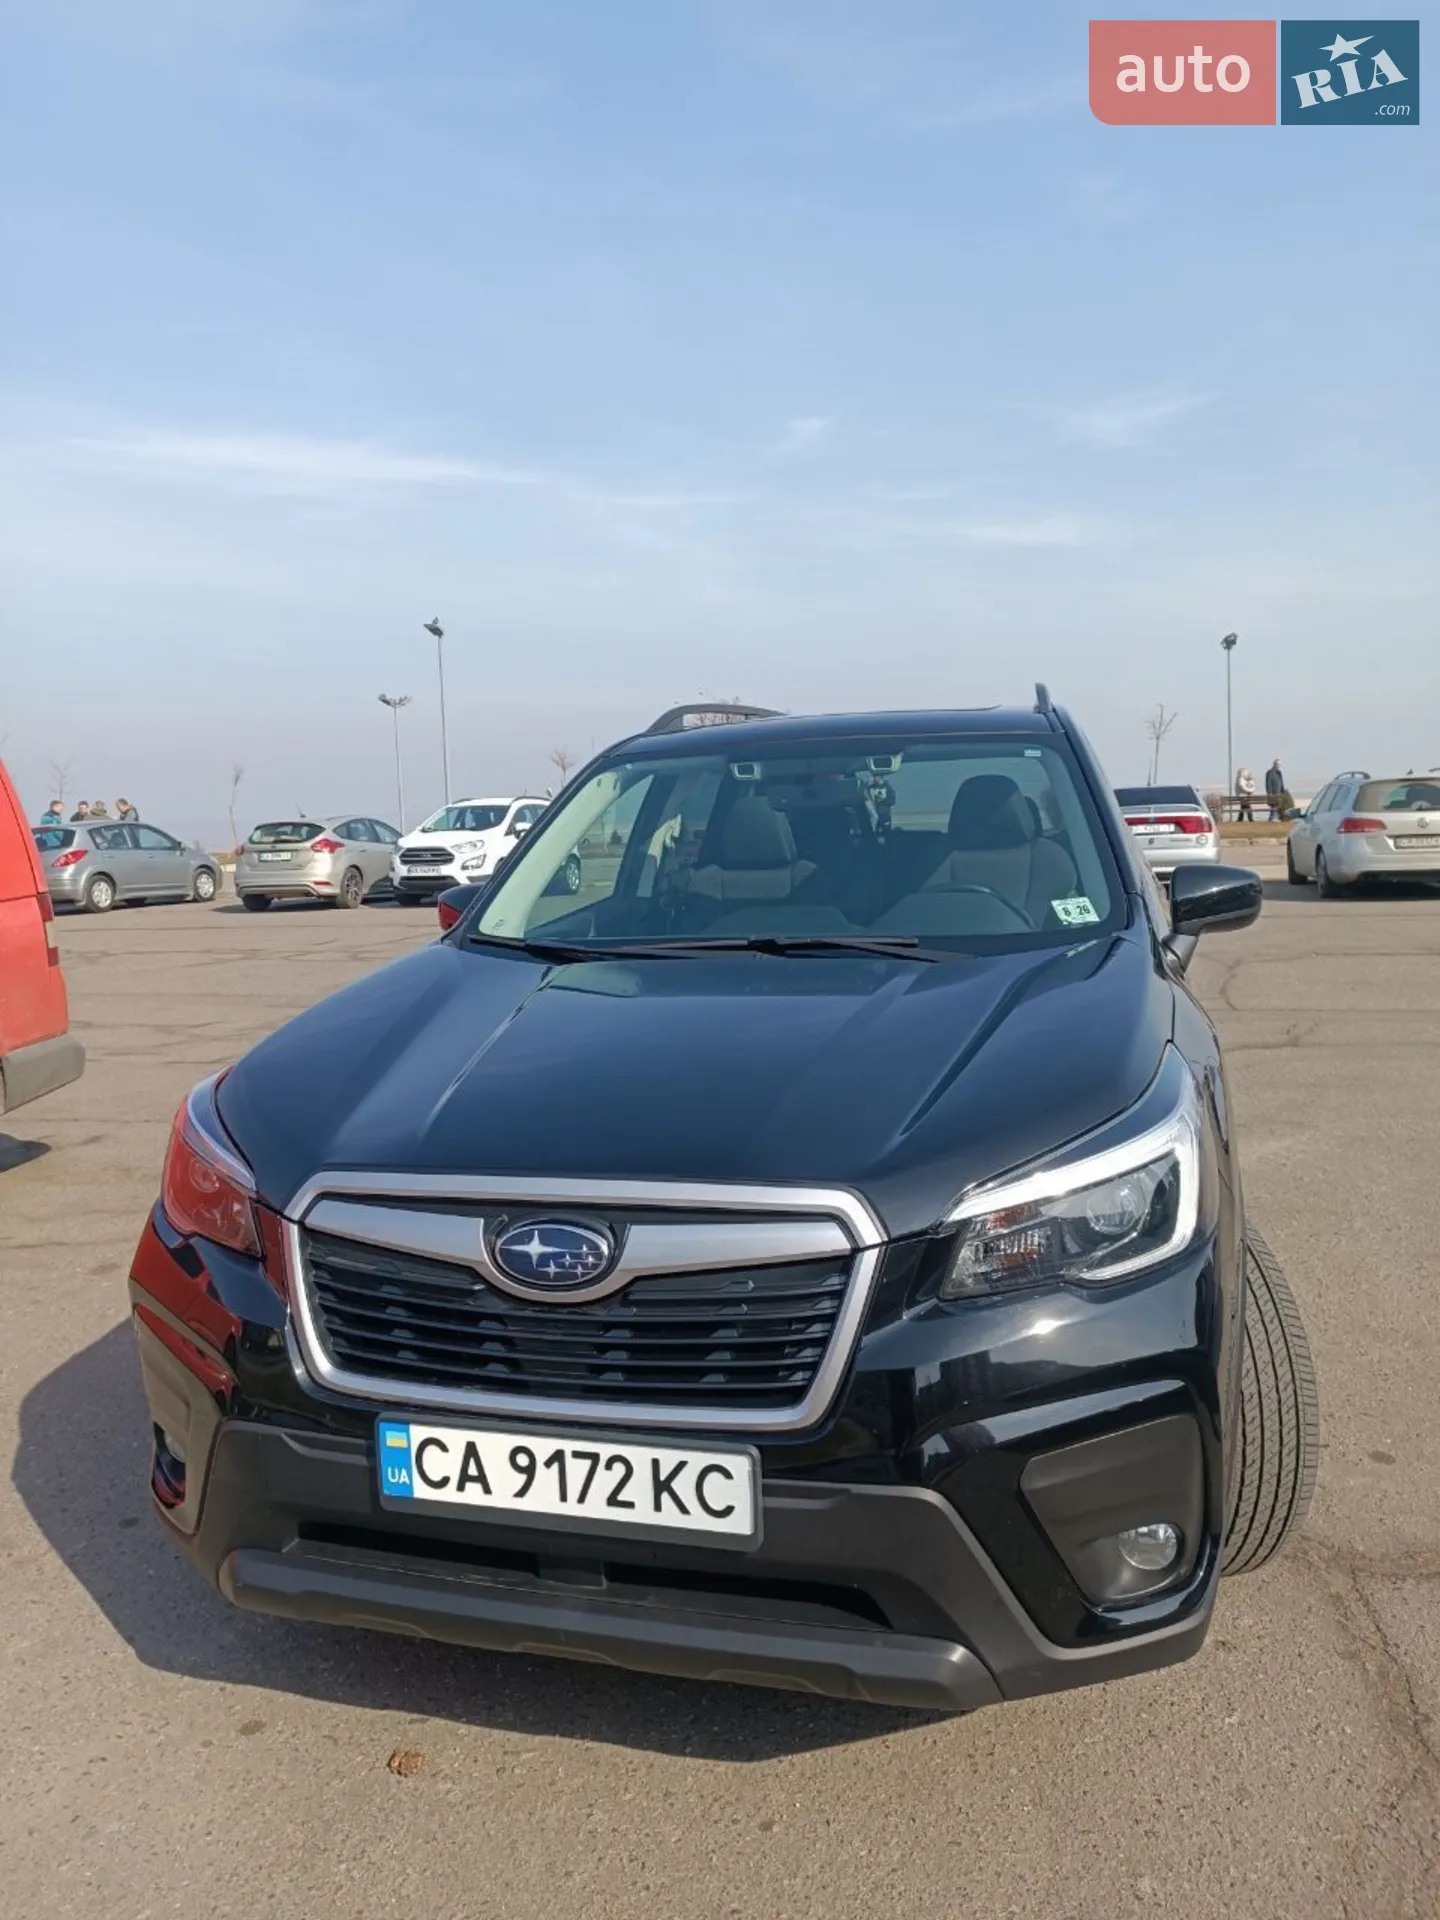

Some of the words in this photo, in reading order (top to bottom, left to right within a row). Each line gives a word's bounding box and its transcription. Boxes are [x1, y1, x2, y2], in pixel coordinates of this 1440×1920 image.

[387, 1466, 410, 1485] UA
[414, 1436, 493, 1496] CA
[508, 1445, 636, 1510] 9172
[651, 1457, 736, 1519] KC
